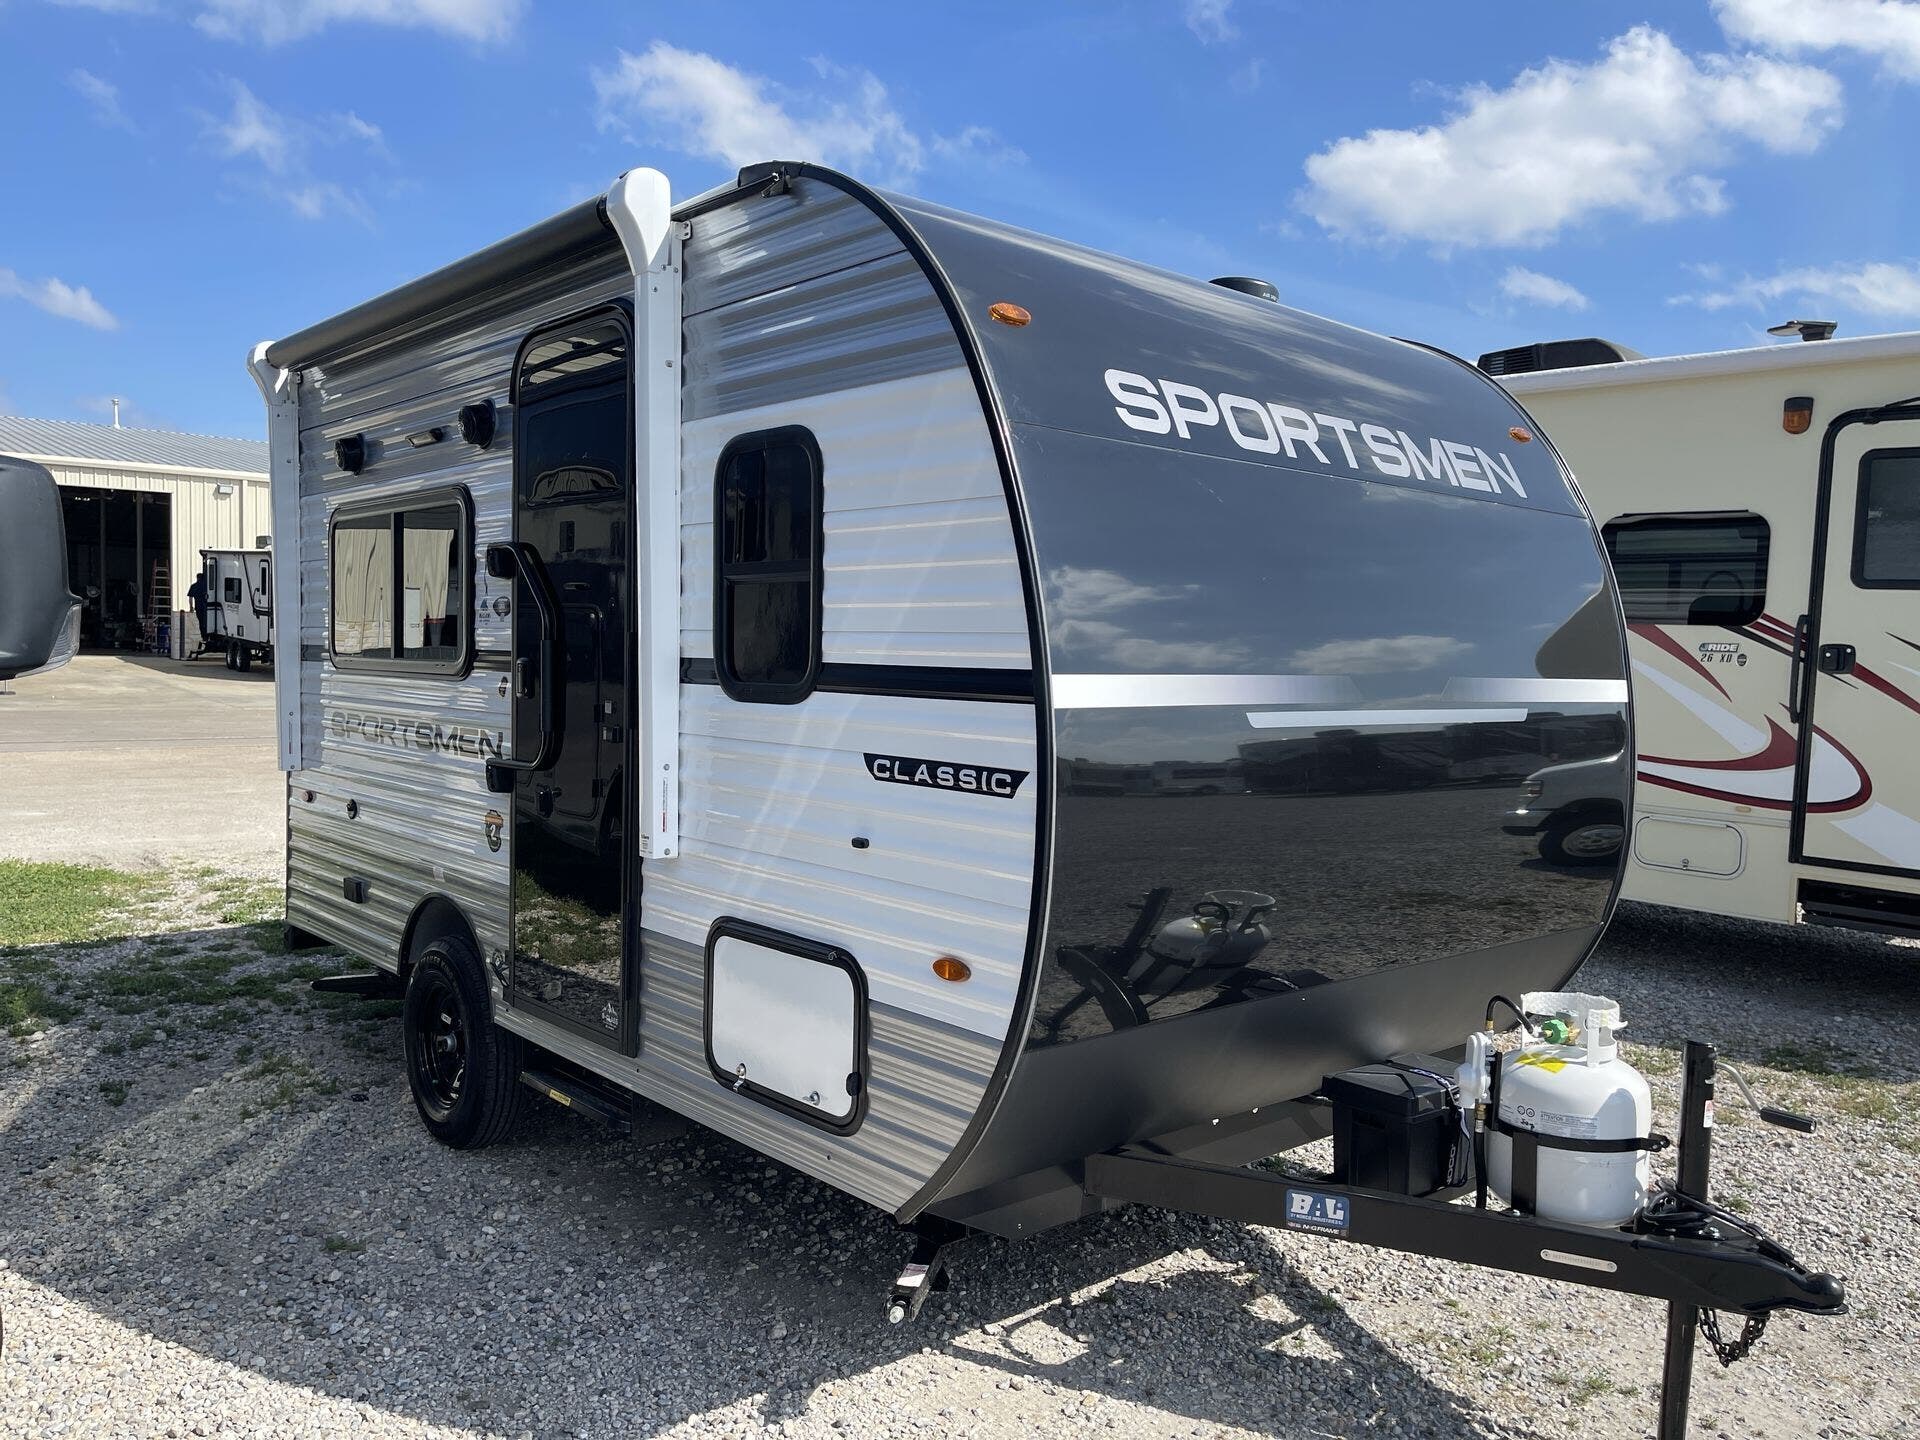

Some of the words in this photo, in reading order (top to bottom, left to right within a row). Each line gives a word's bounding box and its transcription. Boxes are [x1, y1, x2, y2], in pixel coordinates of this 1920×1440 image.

[1104, 368, 1528, 498] SPORTSMEN
[1700, 653, 1714, 663] 26
[331, 711, 504, 760] SPORTSMEN
[873, 758, 1012, 795] CLASSIC
